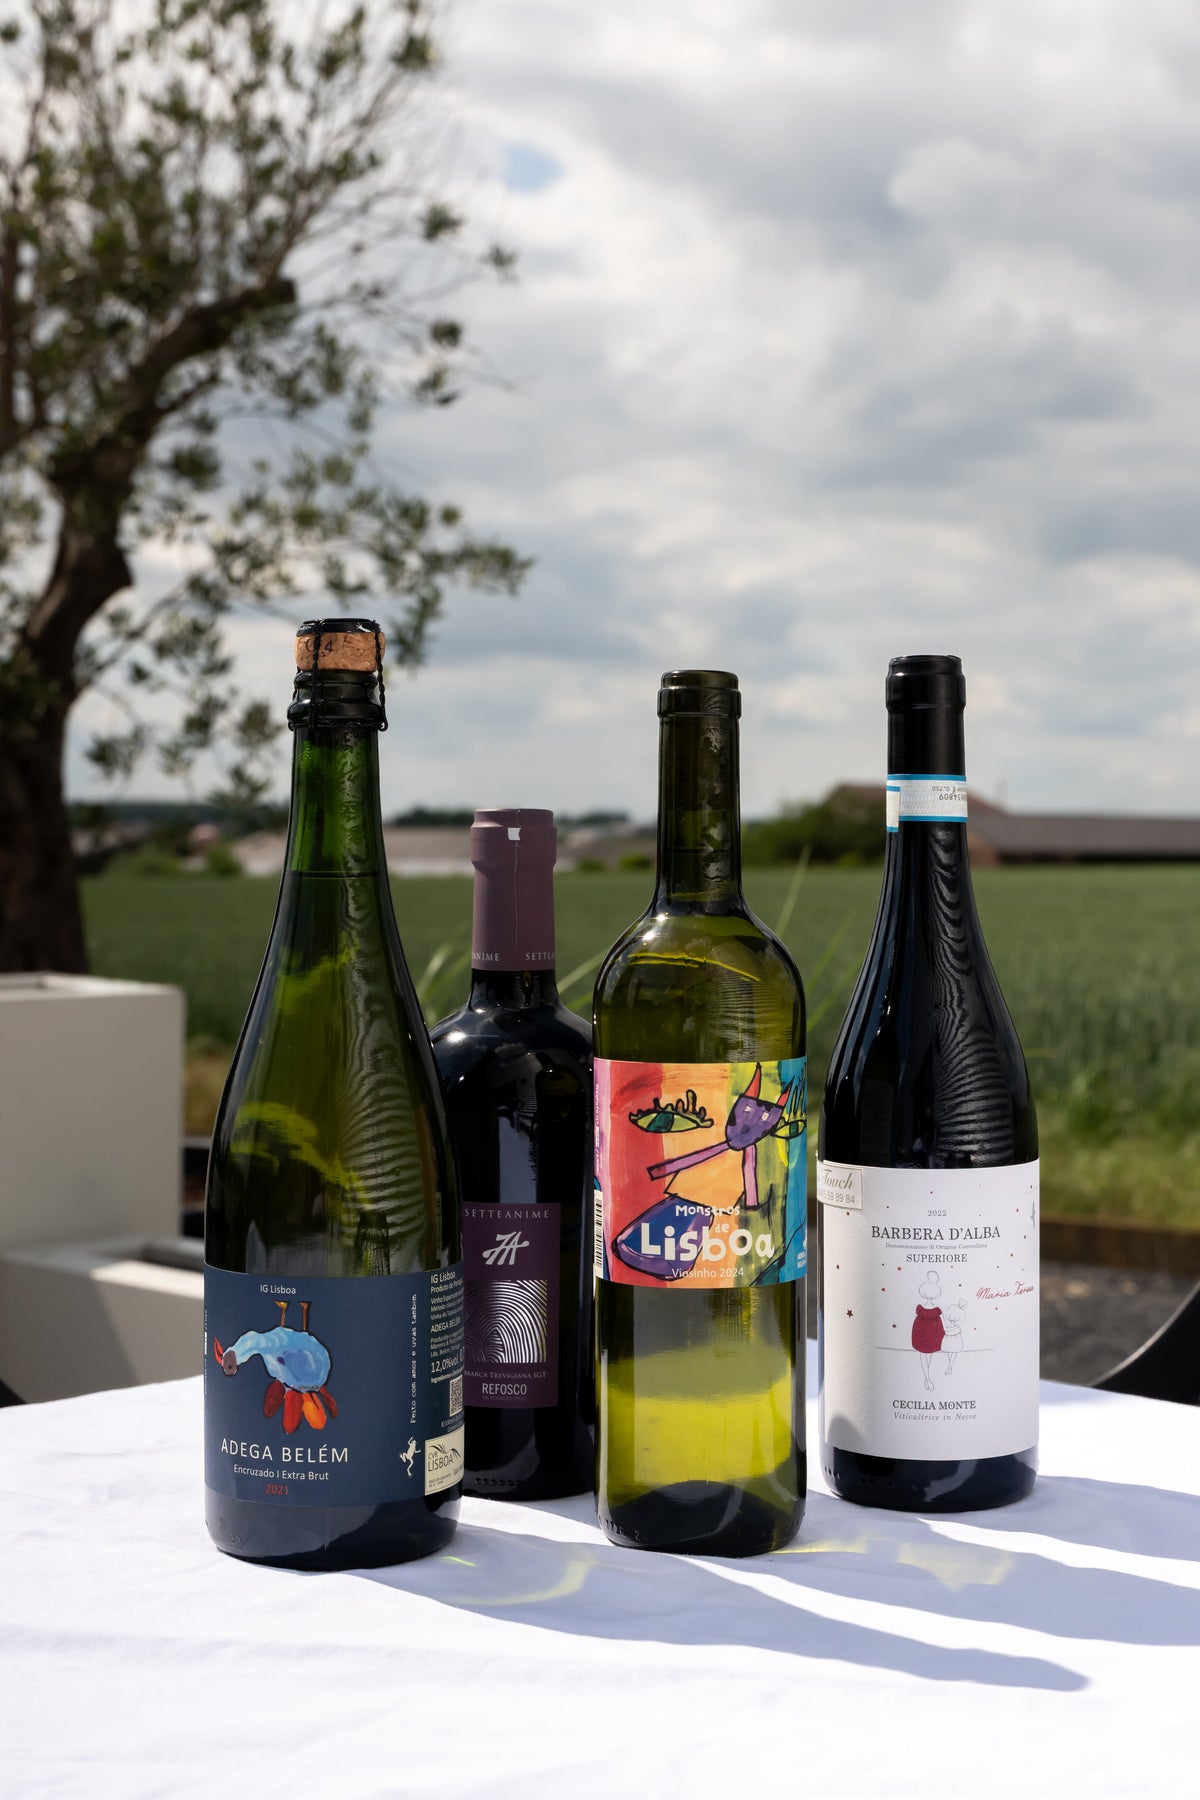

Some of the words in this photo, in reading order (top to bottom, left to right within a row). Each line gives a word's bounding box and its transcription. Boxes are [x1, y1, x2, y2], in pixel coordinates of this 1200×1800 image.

[822, 1169, 855, 1190] Touch
[464, 1208, 550, 1219] SETTEANIME
[675, 1205, 741, 1217] Monstros
[927, 1209, 947, 1217] 2022
[714, 1222, 730, 1233] de
[871, 1225, 945, 1241] BARBERA
[936, 1243, 957, 1251] Origine
[906, 1254, 968, 1263] SUPERIORE
[672, 1267, 717, 1278] Viosinho
[719, 1267, 744, 1278] 2024
[260, 1284, 269, 1293] IG
[270, 1285, 296, 1295] Lisboa
[976, 1286, 1012, 1301] Maria
[464, 1370, 488, 1378] MARCA
[490, 1371, 532, 1380] TREVIGIANA
[482, 1383, 528, 1395] REFOSCO
[892, 1399, 936, 1410] CECILIA
[939, 1400, 977, 1410] MONTE
[893, 1411, 940, 1421] Viticultrice
[943, 1412, 953, 1421] in
[955, 1412, 977, 1421] Neive
[221, 1438, 273, 1461] ADEGA
[282, 1444, 348, 1463] BELÉM
[427, 1454, 454, 1472] LISBOA
[233, 1464, 274, 1479] Encruzado
[282, 1470, 306, 1480] Extra
[308, 1471, 329, 1481] Brut
[265, 1483, 289, 1496] 2021
